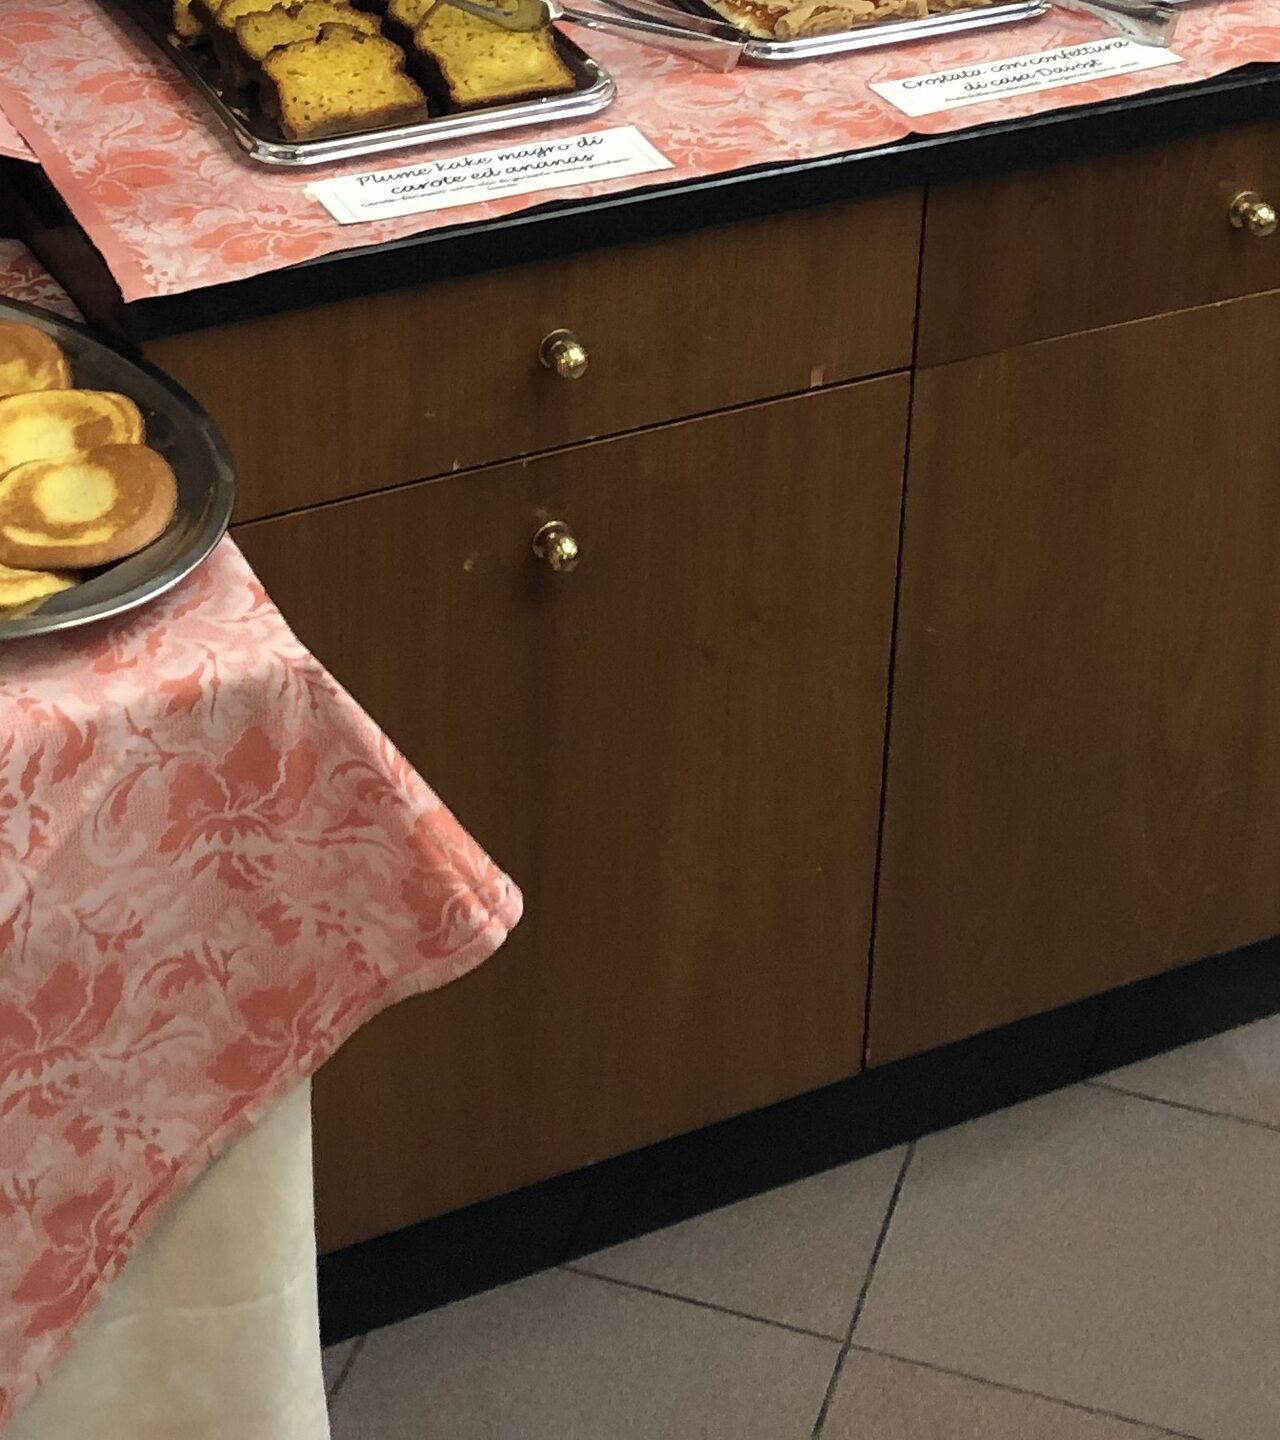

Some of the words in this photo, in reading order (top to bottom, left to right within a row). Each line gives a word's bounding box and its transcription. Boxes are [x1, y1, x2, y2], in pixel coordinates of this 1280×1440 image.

[902, 69, 987, 90] Crostata
[989, 60, 1028, 73] con
[1029, 40, 1130, 66] confettura
[964, 81, 988, 92] di
[989, 72, 1035, 87] casa
[356, 166, 433, 187] Plume
[498, 143, 573, 160] magro
[577, 135, 604, 149] di
[391, 174, 467, 195] carote
[471, 167, 502, 181] ed
[506, 153, 596, 175] ananas
